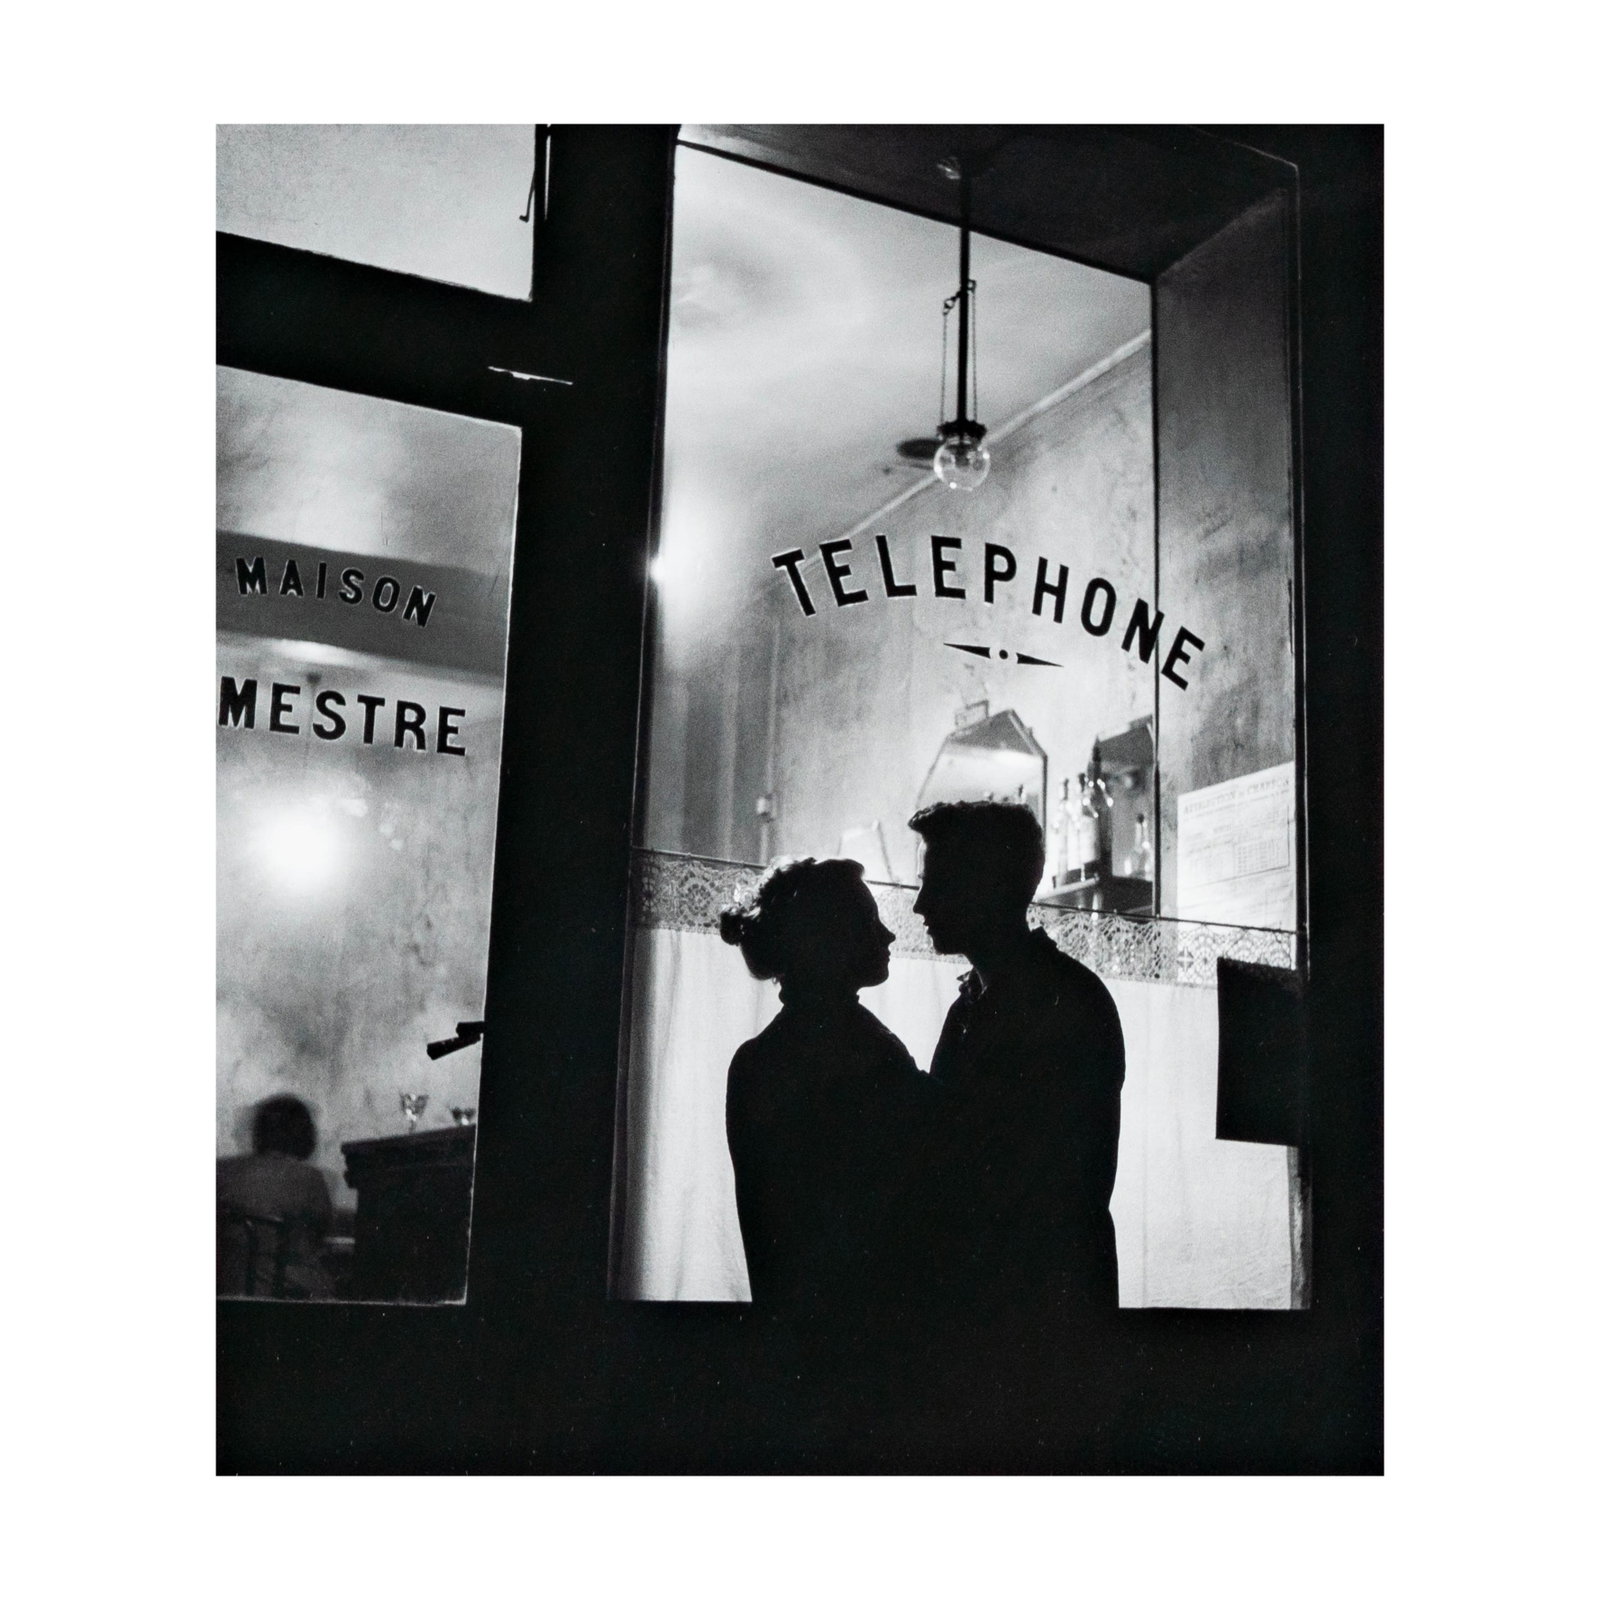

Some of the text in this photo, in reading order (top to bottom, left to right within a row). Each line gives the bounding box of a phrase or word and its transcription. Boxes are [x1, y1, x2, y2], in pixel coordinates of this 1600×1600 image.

[235, 557, 436, 627] MAISON
[771, 535, 1205, 690] TELEPHONE
[218, 676, 466, 756] MESTRE
